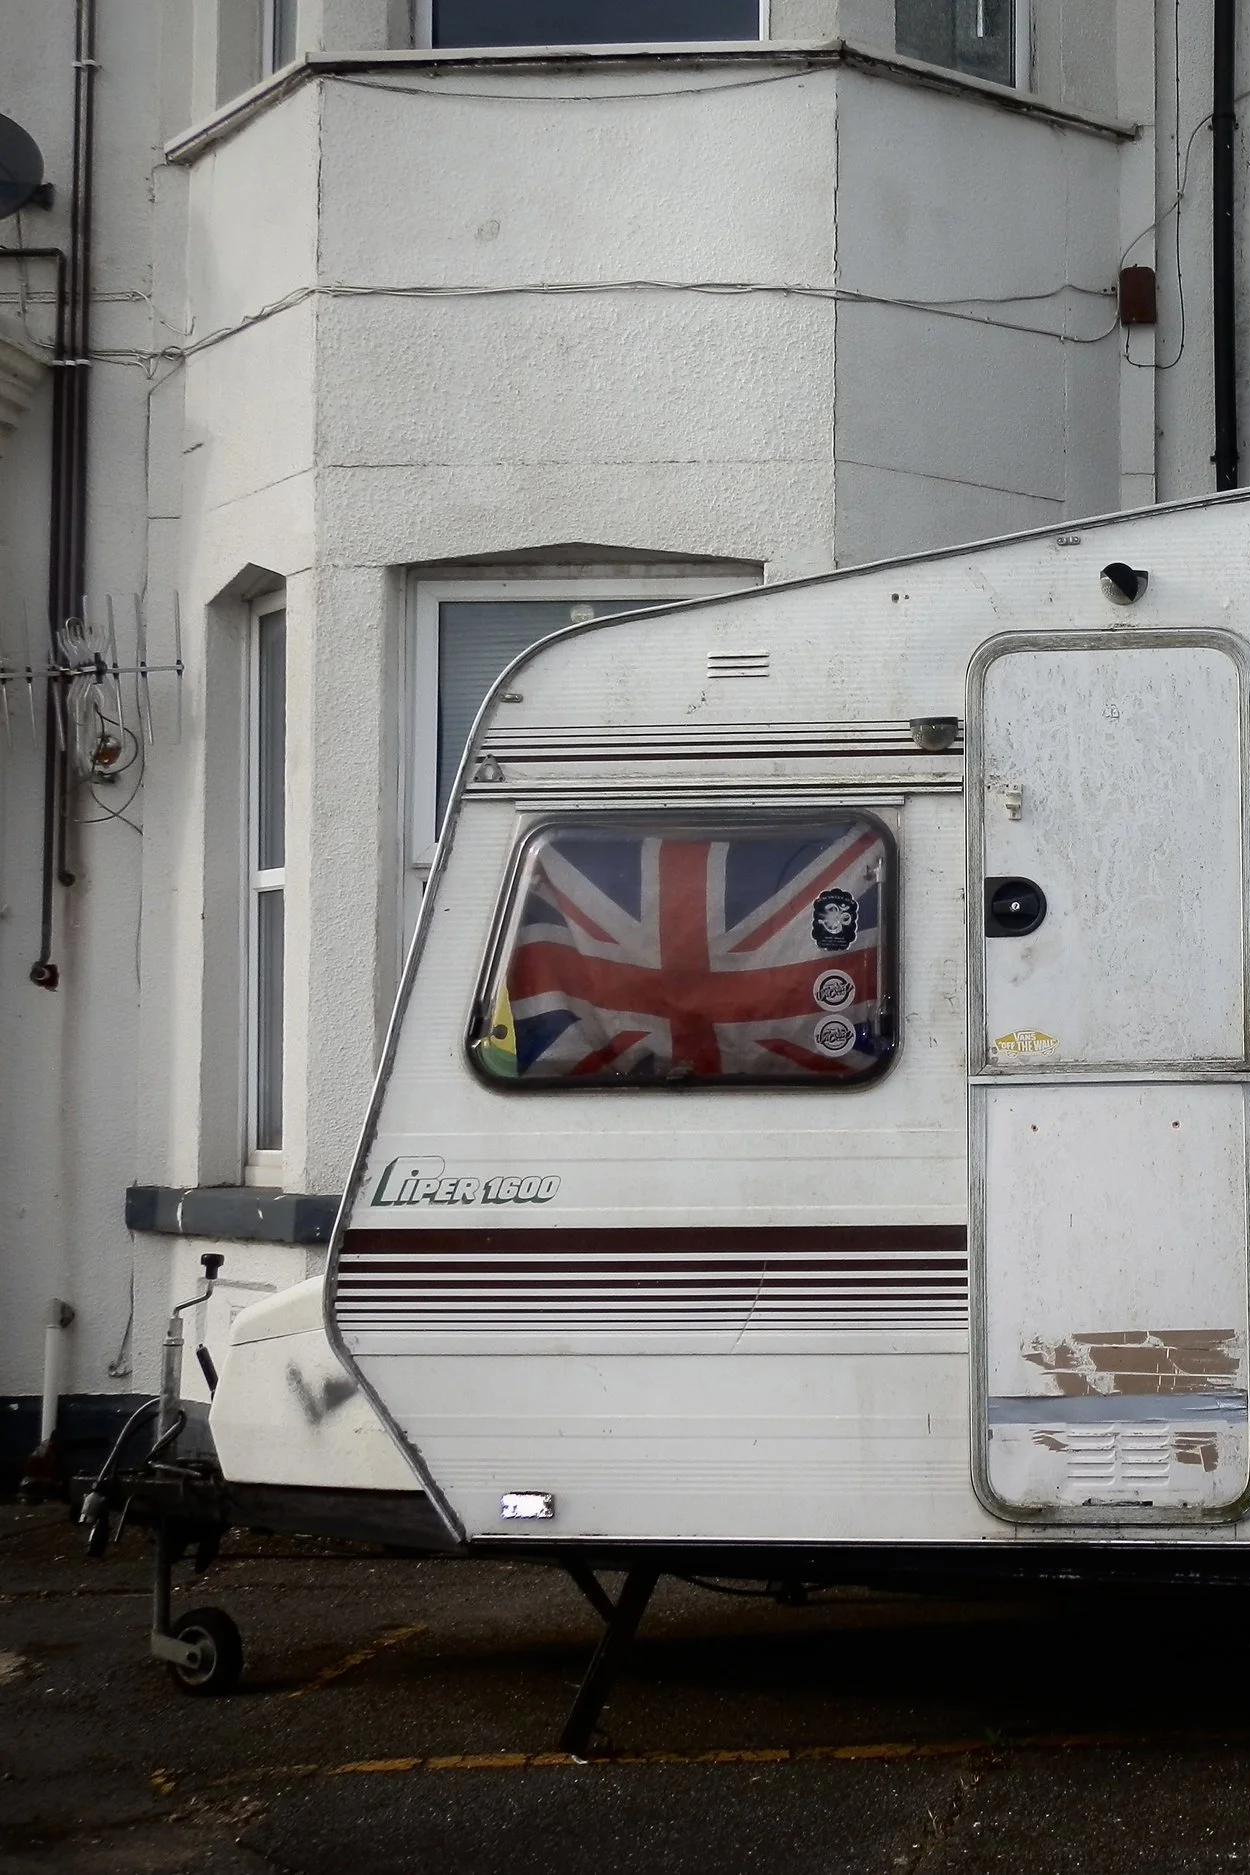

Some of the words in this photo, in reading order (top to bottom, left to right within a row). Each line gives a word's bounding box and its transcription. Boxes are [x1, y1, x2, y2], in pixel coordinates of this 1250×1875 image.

[1013, 1032, 1036, 1041] VANS
[1016, 1040, 1033, 1052] THE
[481, 1175, 561, 1205] 1600
